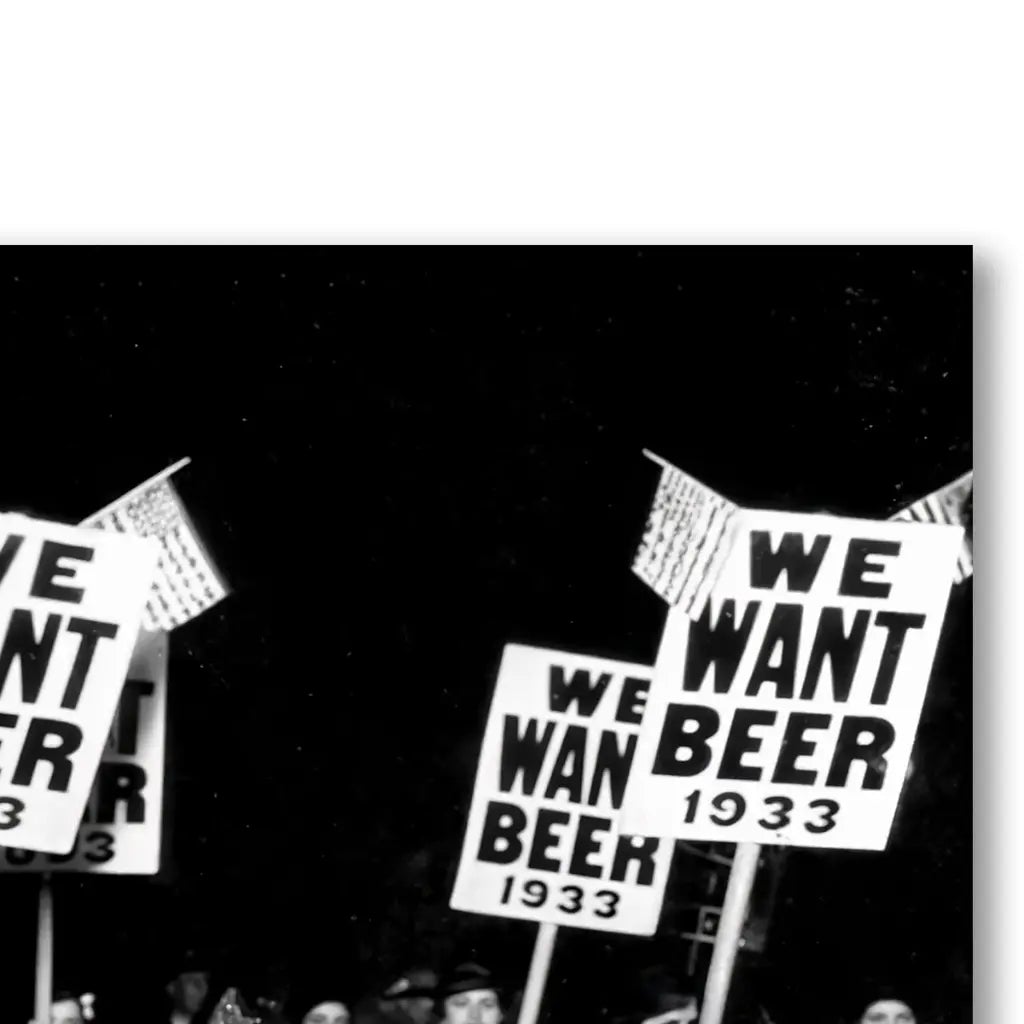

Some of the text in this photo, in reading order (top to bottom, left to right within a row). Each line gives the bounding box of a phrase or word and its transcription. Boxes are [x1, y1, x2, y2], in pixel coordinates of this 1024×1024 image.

[751, 531, 900, 598] WE
[683, 597, 926, 705] WANT
[549, 666, 651, 725] WE
[500, 715, 638, 809] WAN
[652, 703, 895, 790] BEER
[477, 801, 659, 886] BEER
[685, 790, 839, 833] 1933
[501, 877, 619, 918] 1933
